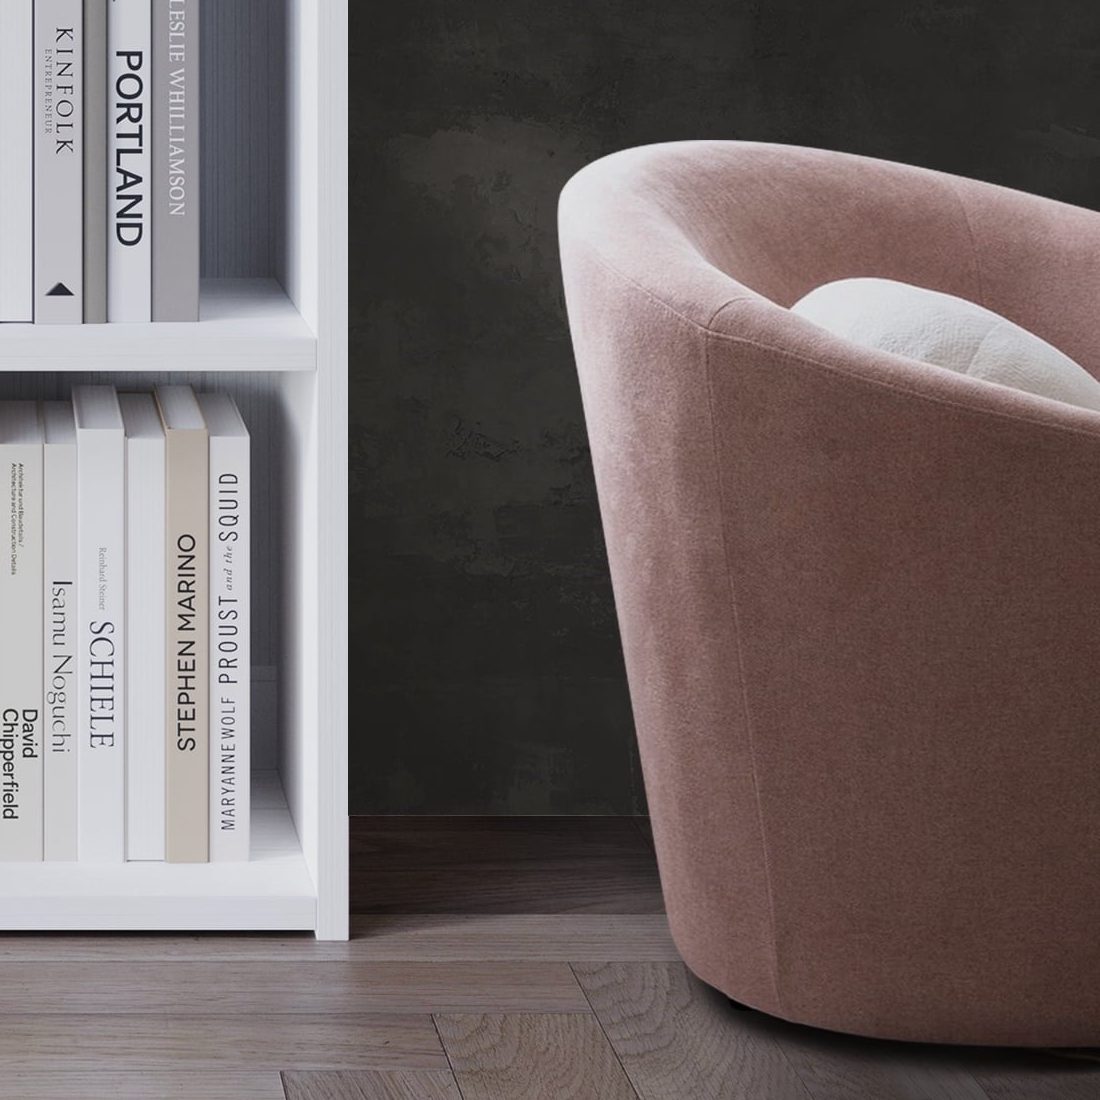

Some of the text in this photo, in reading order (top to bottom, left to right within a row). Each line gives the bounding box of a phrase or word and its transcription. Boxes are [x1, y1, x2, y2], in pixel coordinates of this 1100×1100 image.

[56, 28, 74, 155] KINFOLK
[116, 50, 143, 247] PORTLAND
[168, 68, 185, 216] WHILLIAMSON
[98, 547, 107, 611] Reinhard Steiner
[176, 534, 196, 751] STEPHEN MARINO
[47, 580, 72, 753] Isamu Noguchi
[89, 620, 115, 749] SCHIELE
[218, 473, 239, 831] MARYANNE WOLF PROUST and the SQUID
[0, 708, 18, 820] Chipperfield
[22, 709, 38, 758] David
